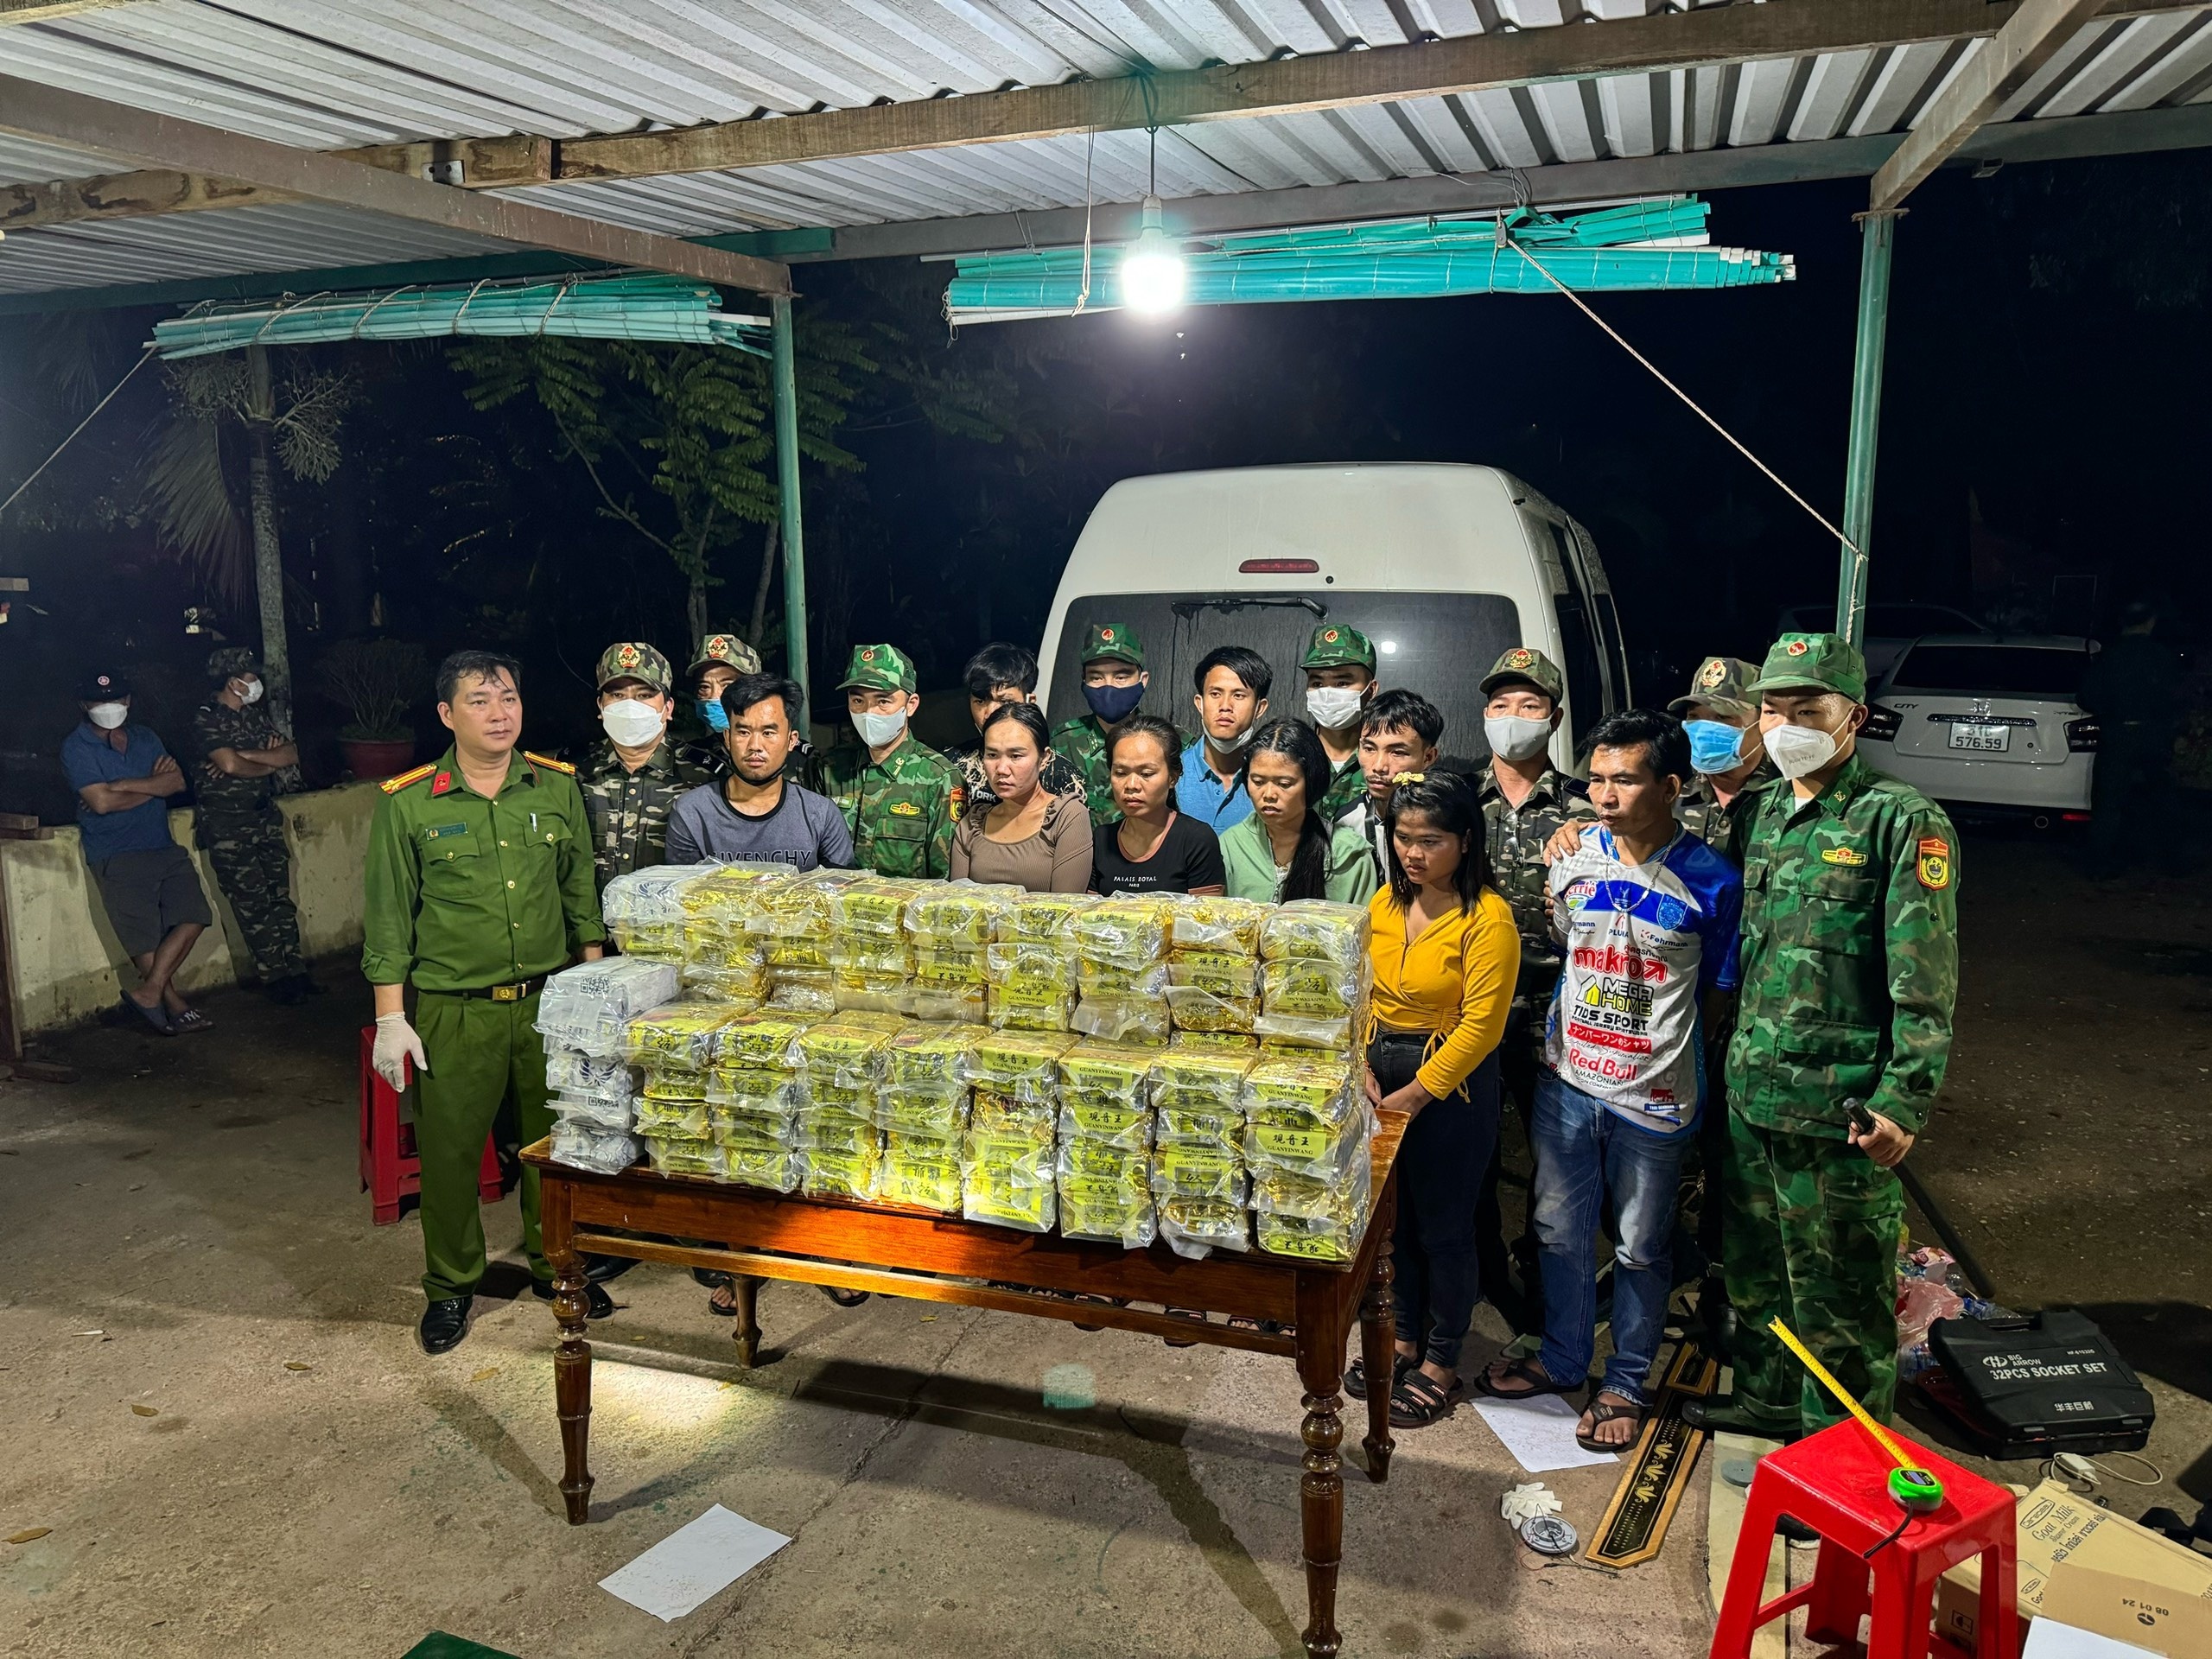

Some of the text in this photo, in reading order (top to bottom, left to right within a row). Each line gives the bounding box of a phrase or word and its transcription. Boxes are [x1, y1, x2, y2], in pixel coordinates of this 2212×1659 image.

[1955, 736, 2002, 749] 576.59
[971, 785, 996, 802] YORK
[714, 850, 812, 867] IVENCHY
[1574, 944, 1643, 979] makro
[1603, 977, 1654, 1001] MEGA
[1601, 993, 1652, 1016] HOME
[1603, 1013, 1649, 1031] SPORT
[1079, 1067, 1122, 1076] GUANYINWANG
[1569, 1049, 1599, 1071] Red
[1602, 1058, 1637, 1080] Bull
[1268, 1090, 1313, 1101] GUANYINWANG
[1089, 1112, 1122, 1122] 观音王
[1274, 1134, 1309, 1146] 观音王
[1268, 1146, 1313, 1154] GUANYINWANG
[1990, 1363, 2107, 1380] 32PCS SOCKET SET
[2031, 1522, 2056, 1541] Goat
[2050, 1505, 2075, 1523] Milk
